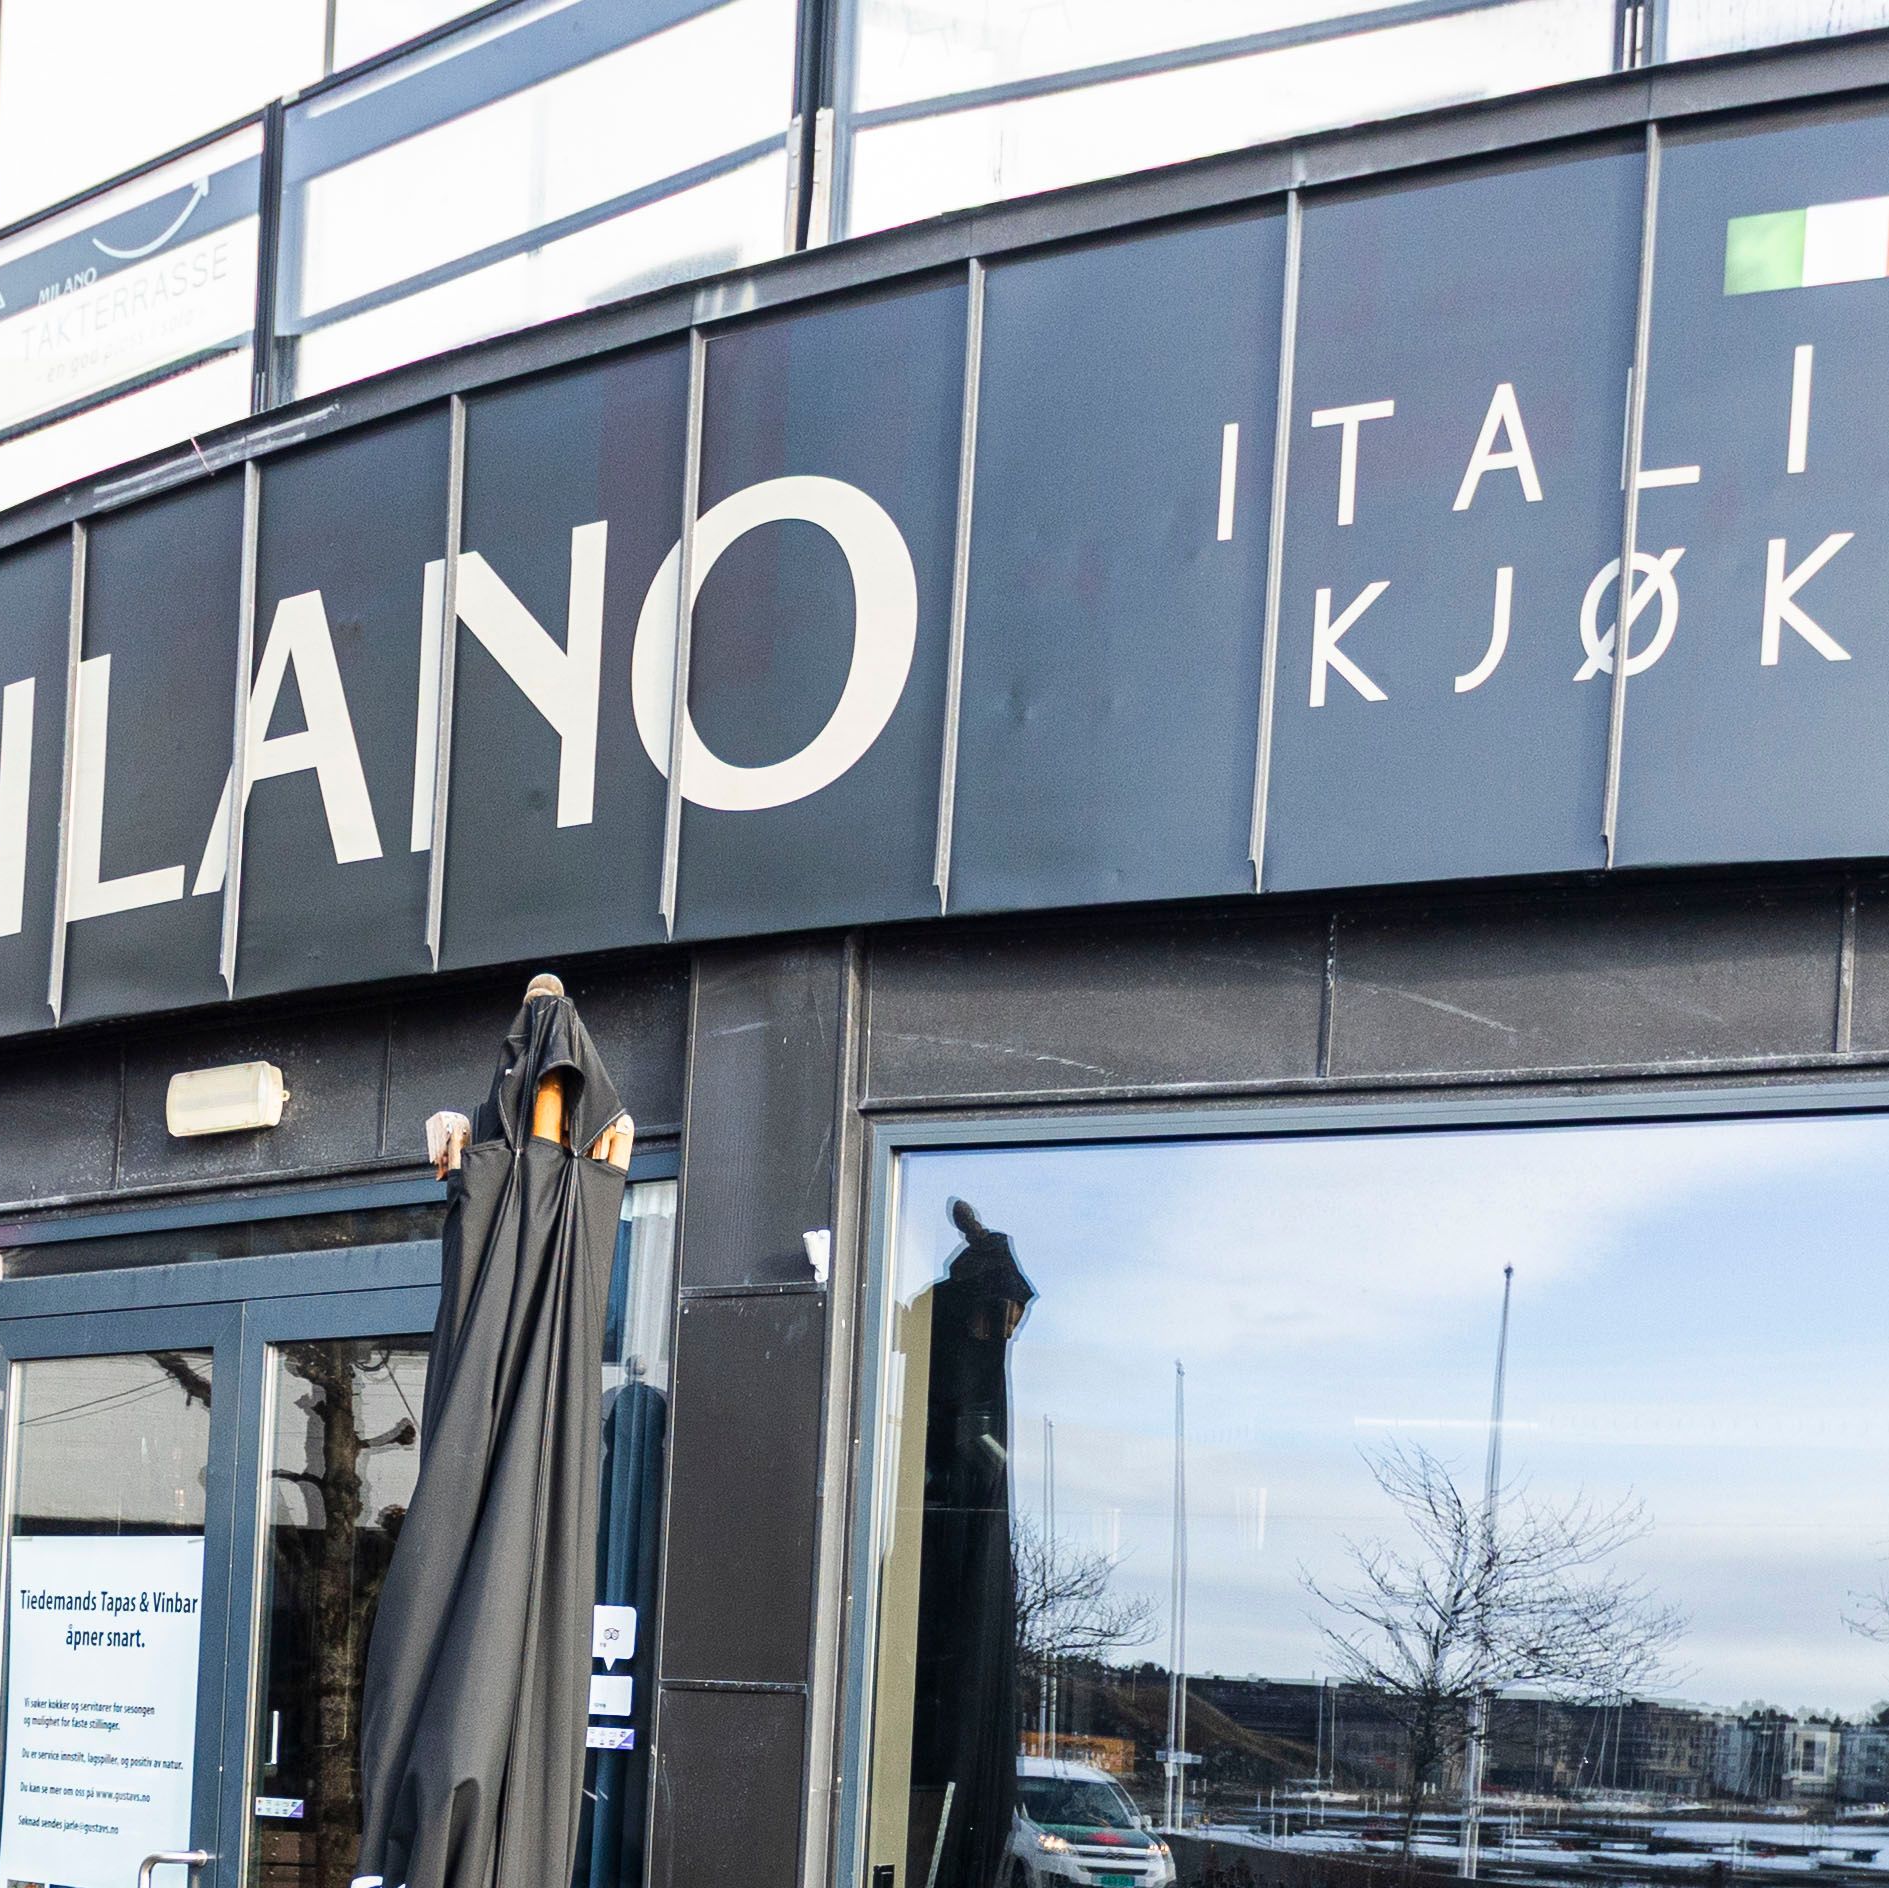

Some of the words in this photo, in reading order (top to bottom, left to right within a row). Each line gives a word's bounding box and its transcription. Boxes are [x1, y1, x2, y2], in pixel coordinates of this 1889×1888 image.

[38, 267, 96, 306] MILANO
[20, 1589, 97, 1611] Tiedemands
[101, 1591, 136, 1617] Tapas
[139, 1591, 149, 1612] &
[153, 1591, 199, 1613] Vinbar
[65, 1624, 104, 1651] åpner
[107, 1629, 145, 1648] snart.
[48, 1699, 70, 1710] kokker
[70, 1703, 79, 1713] og
